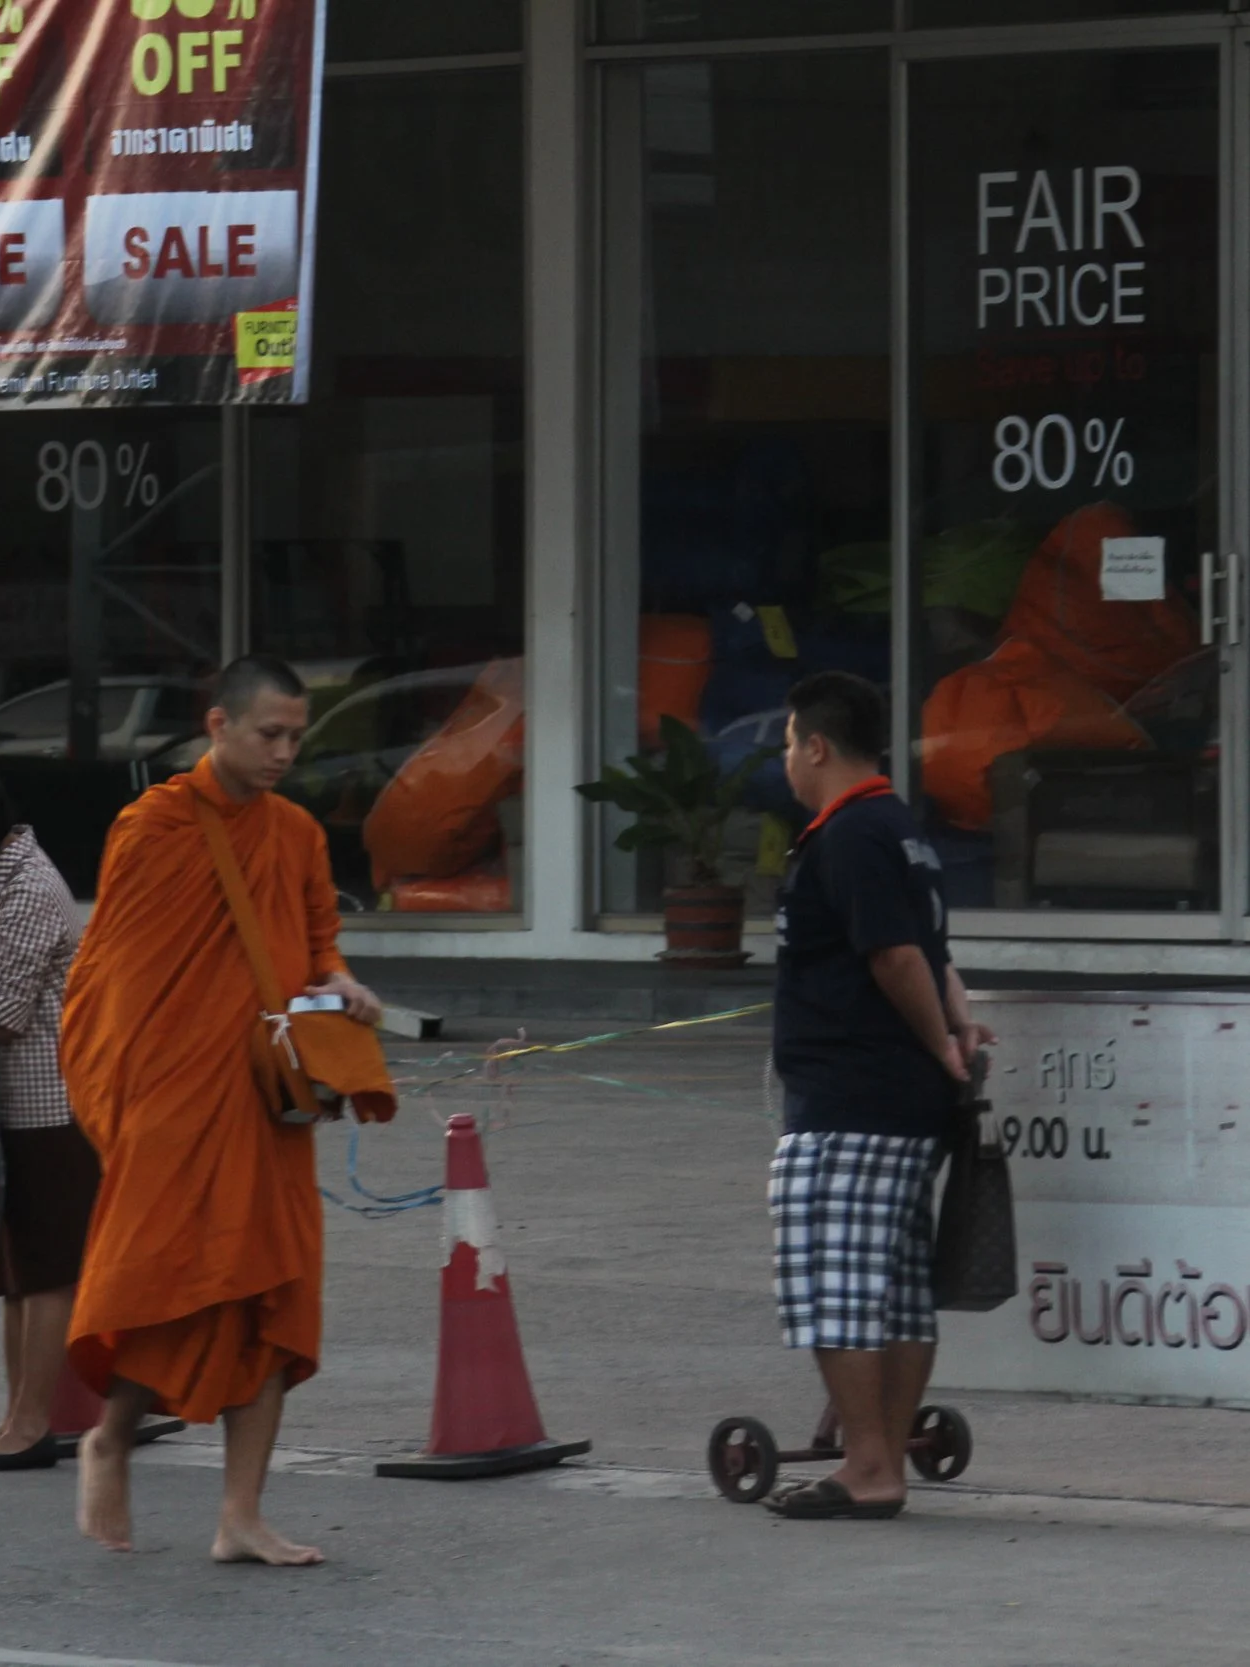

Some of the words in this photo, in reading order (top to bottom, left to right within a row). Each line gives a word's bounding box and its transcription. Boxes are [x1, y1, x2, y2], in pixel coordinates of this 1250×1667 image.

[131, 29, 244, 97] OFF
[977, 166, 1145, 255] FAIR
[123, 223, 258, 280] SALE
[977, 262, 1146, 329] PRICE
[36, 439, 160, 512] 80%
[992, 413, 1135, 493] 80%
[1029, 1258, 1250, 1352] ยินดีต้อ
